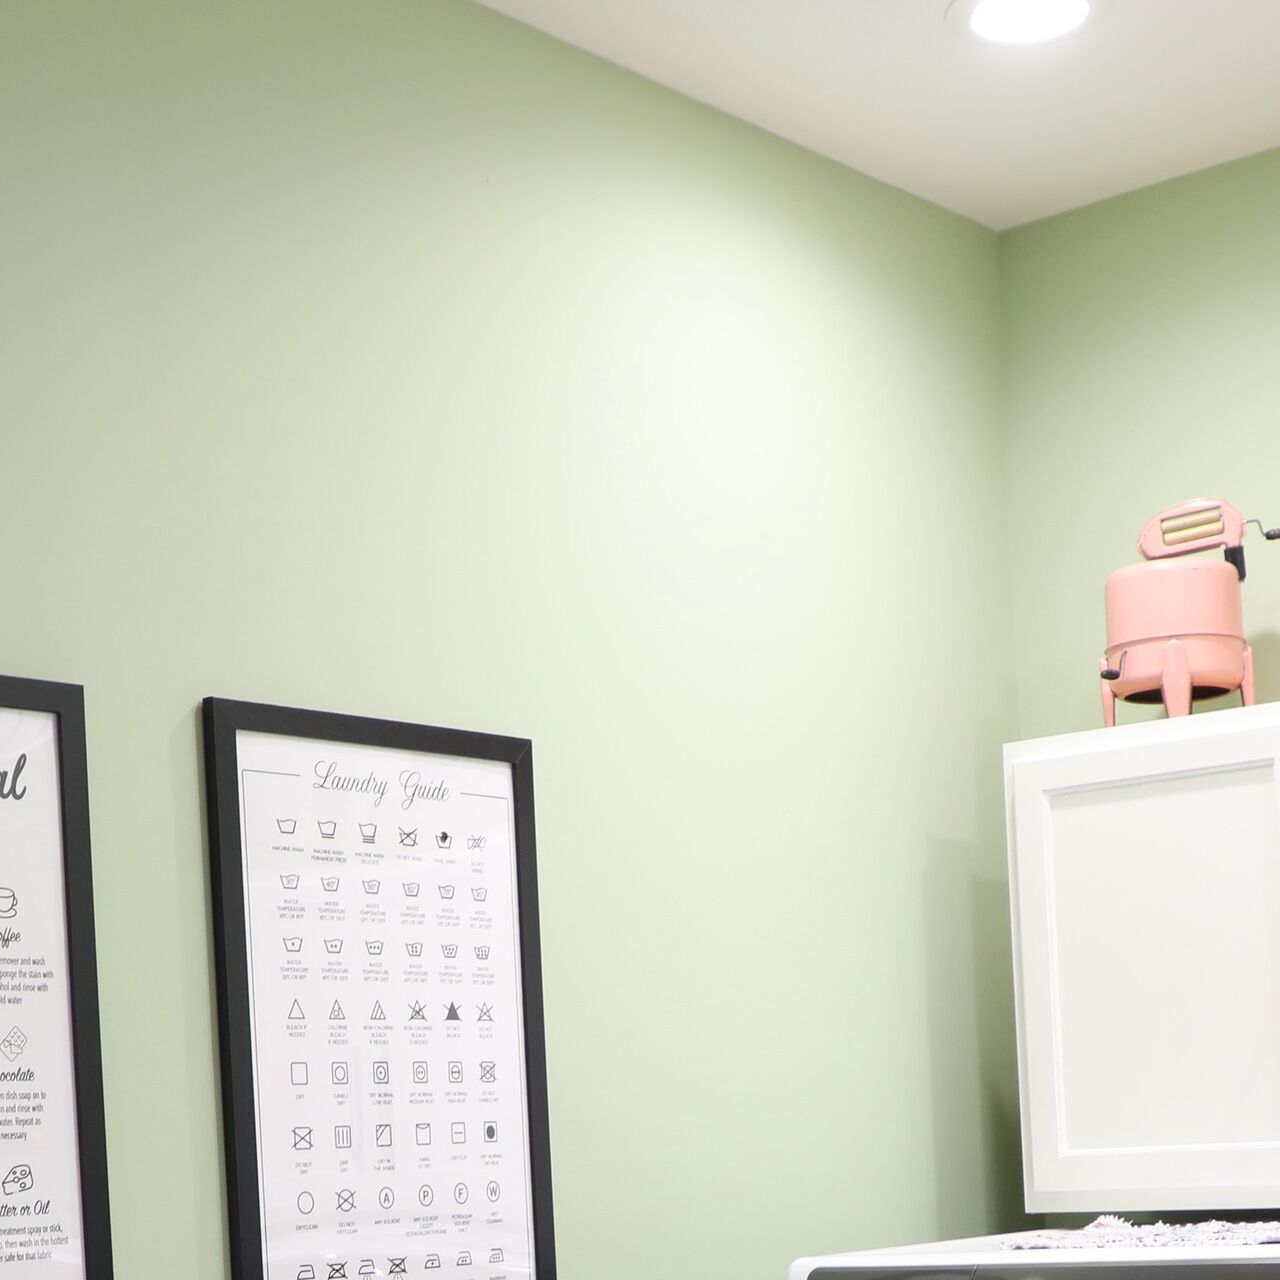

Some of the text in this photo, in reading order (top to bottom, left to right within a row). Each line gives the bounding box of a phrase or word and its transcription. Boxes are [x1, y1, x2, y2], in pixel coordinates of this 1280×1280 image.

[313, 760, 451, 811] Laundry Guide
[20, 1203, 31, 1216] or
[34, 1200, 50, 1216] Oil
